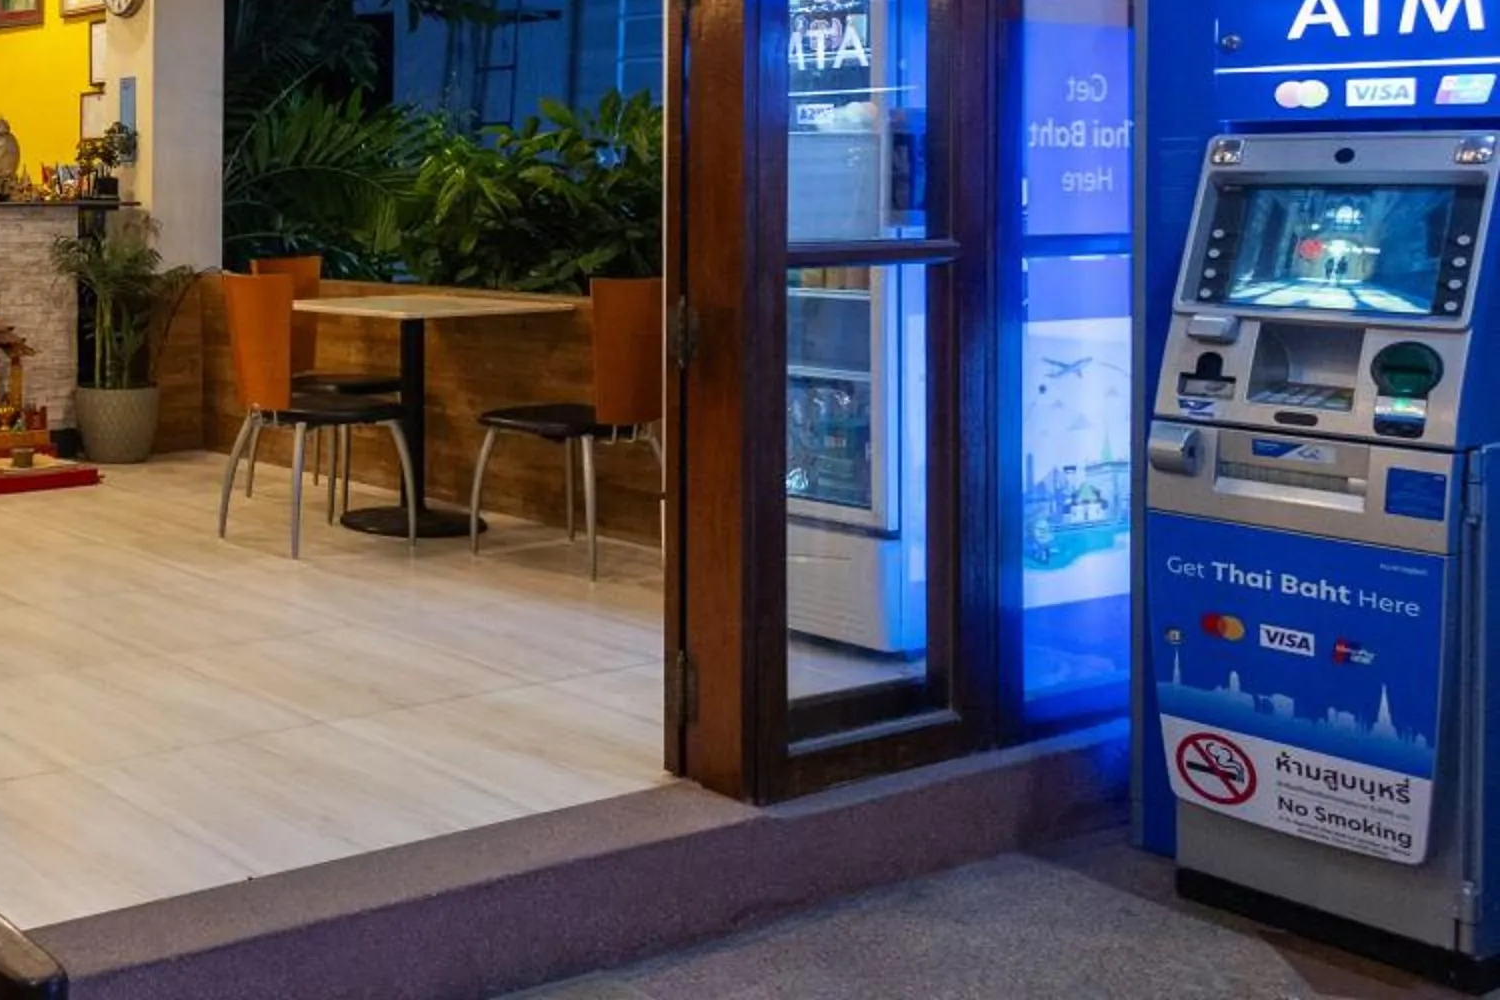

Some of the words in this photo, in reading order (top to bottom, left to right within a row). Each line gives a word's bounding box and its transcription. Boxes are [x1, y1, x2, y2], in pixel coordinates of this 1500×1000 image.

[1352, 83, 1410, 101] VISA
[1167, 555, 1205, 580] Get
[1211, 561, 1272, 590] Thai
[1281, 573, 1351, 606] Baht
[1359, 589, 1421, 617] Here
[1263, 628, 1312, 653] VISA
[1278, 796, 1308, 817] No
[1315, 806, 1412, 849] Smoking
